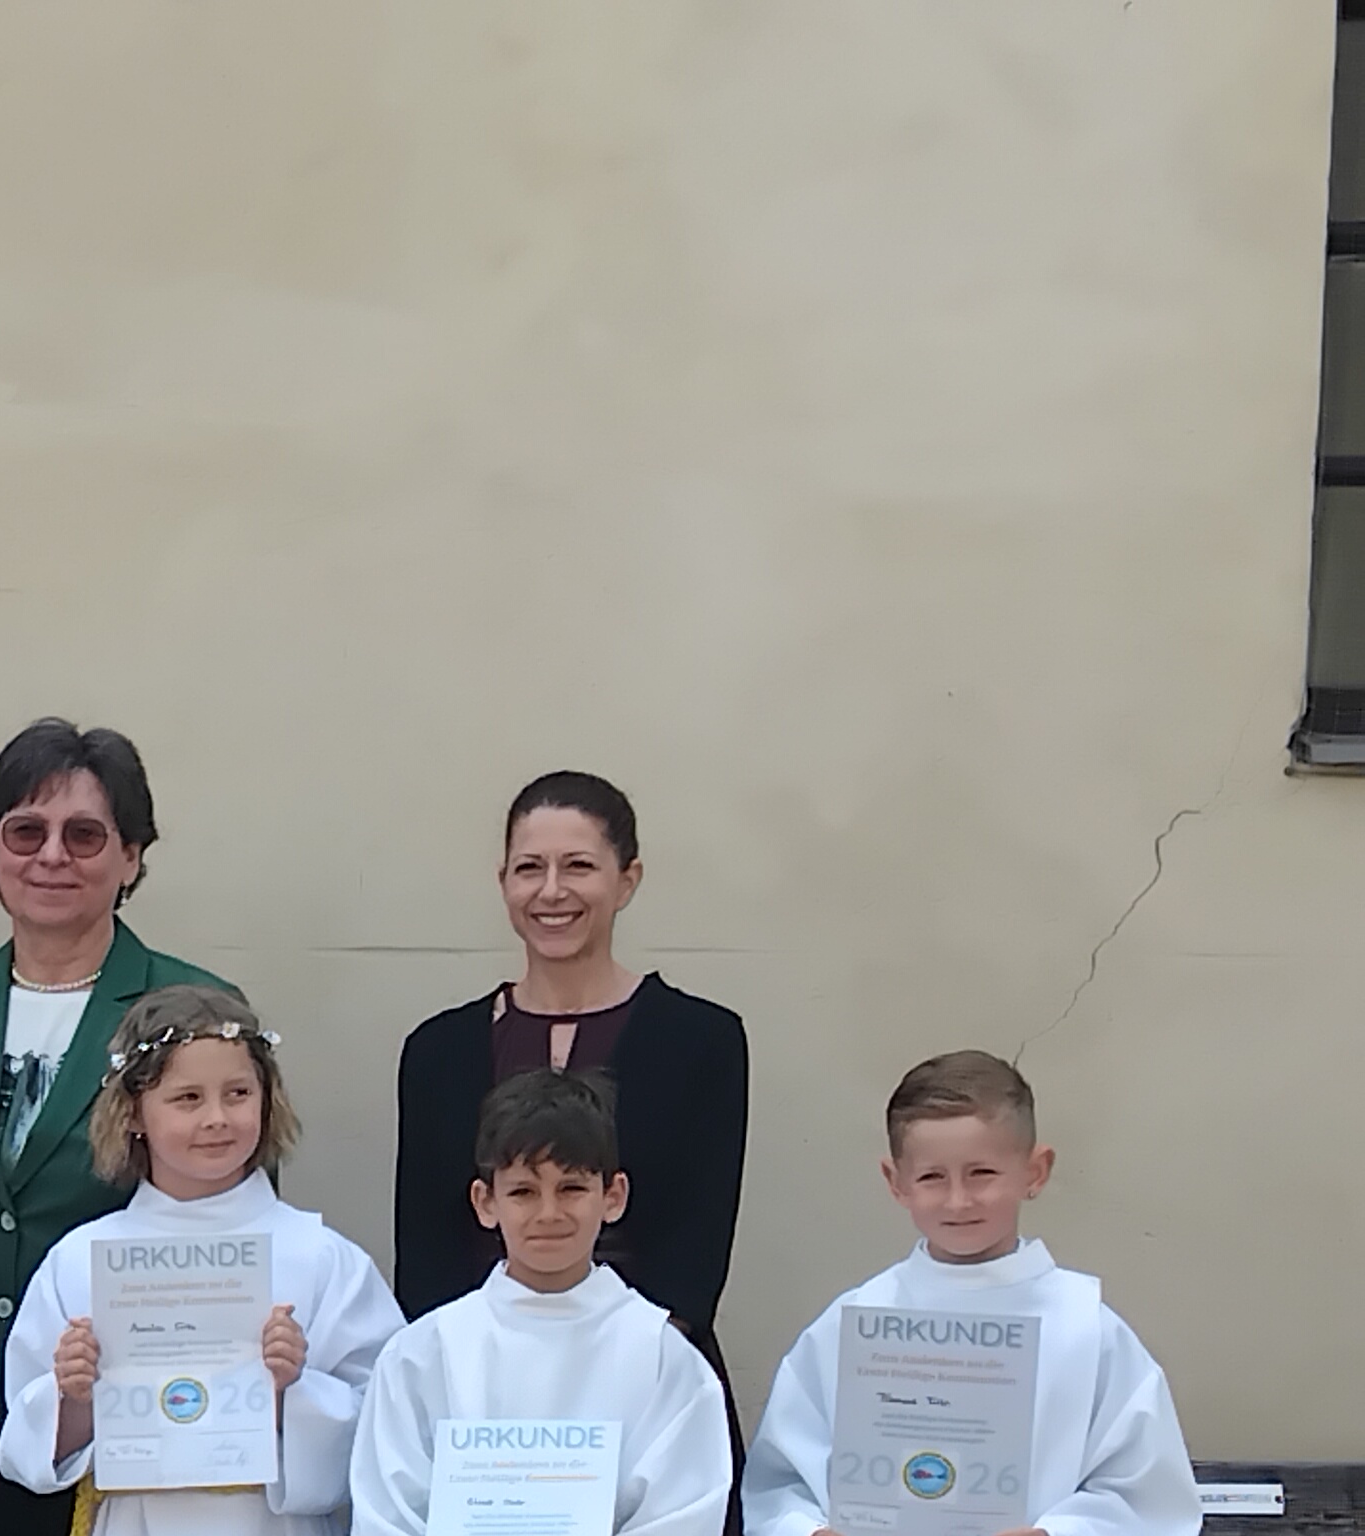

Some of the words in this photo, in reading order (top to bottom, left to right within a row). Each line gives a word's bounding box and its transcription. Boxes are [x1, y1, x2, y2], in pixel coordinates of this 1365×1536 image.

[106, 1241, 257, 1272] URKUNDE
[858, 1315, 1024, 1349] URKUNDE
[450, 1426, 607, 1450] URKUNDE
